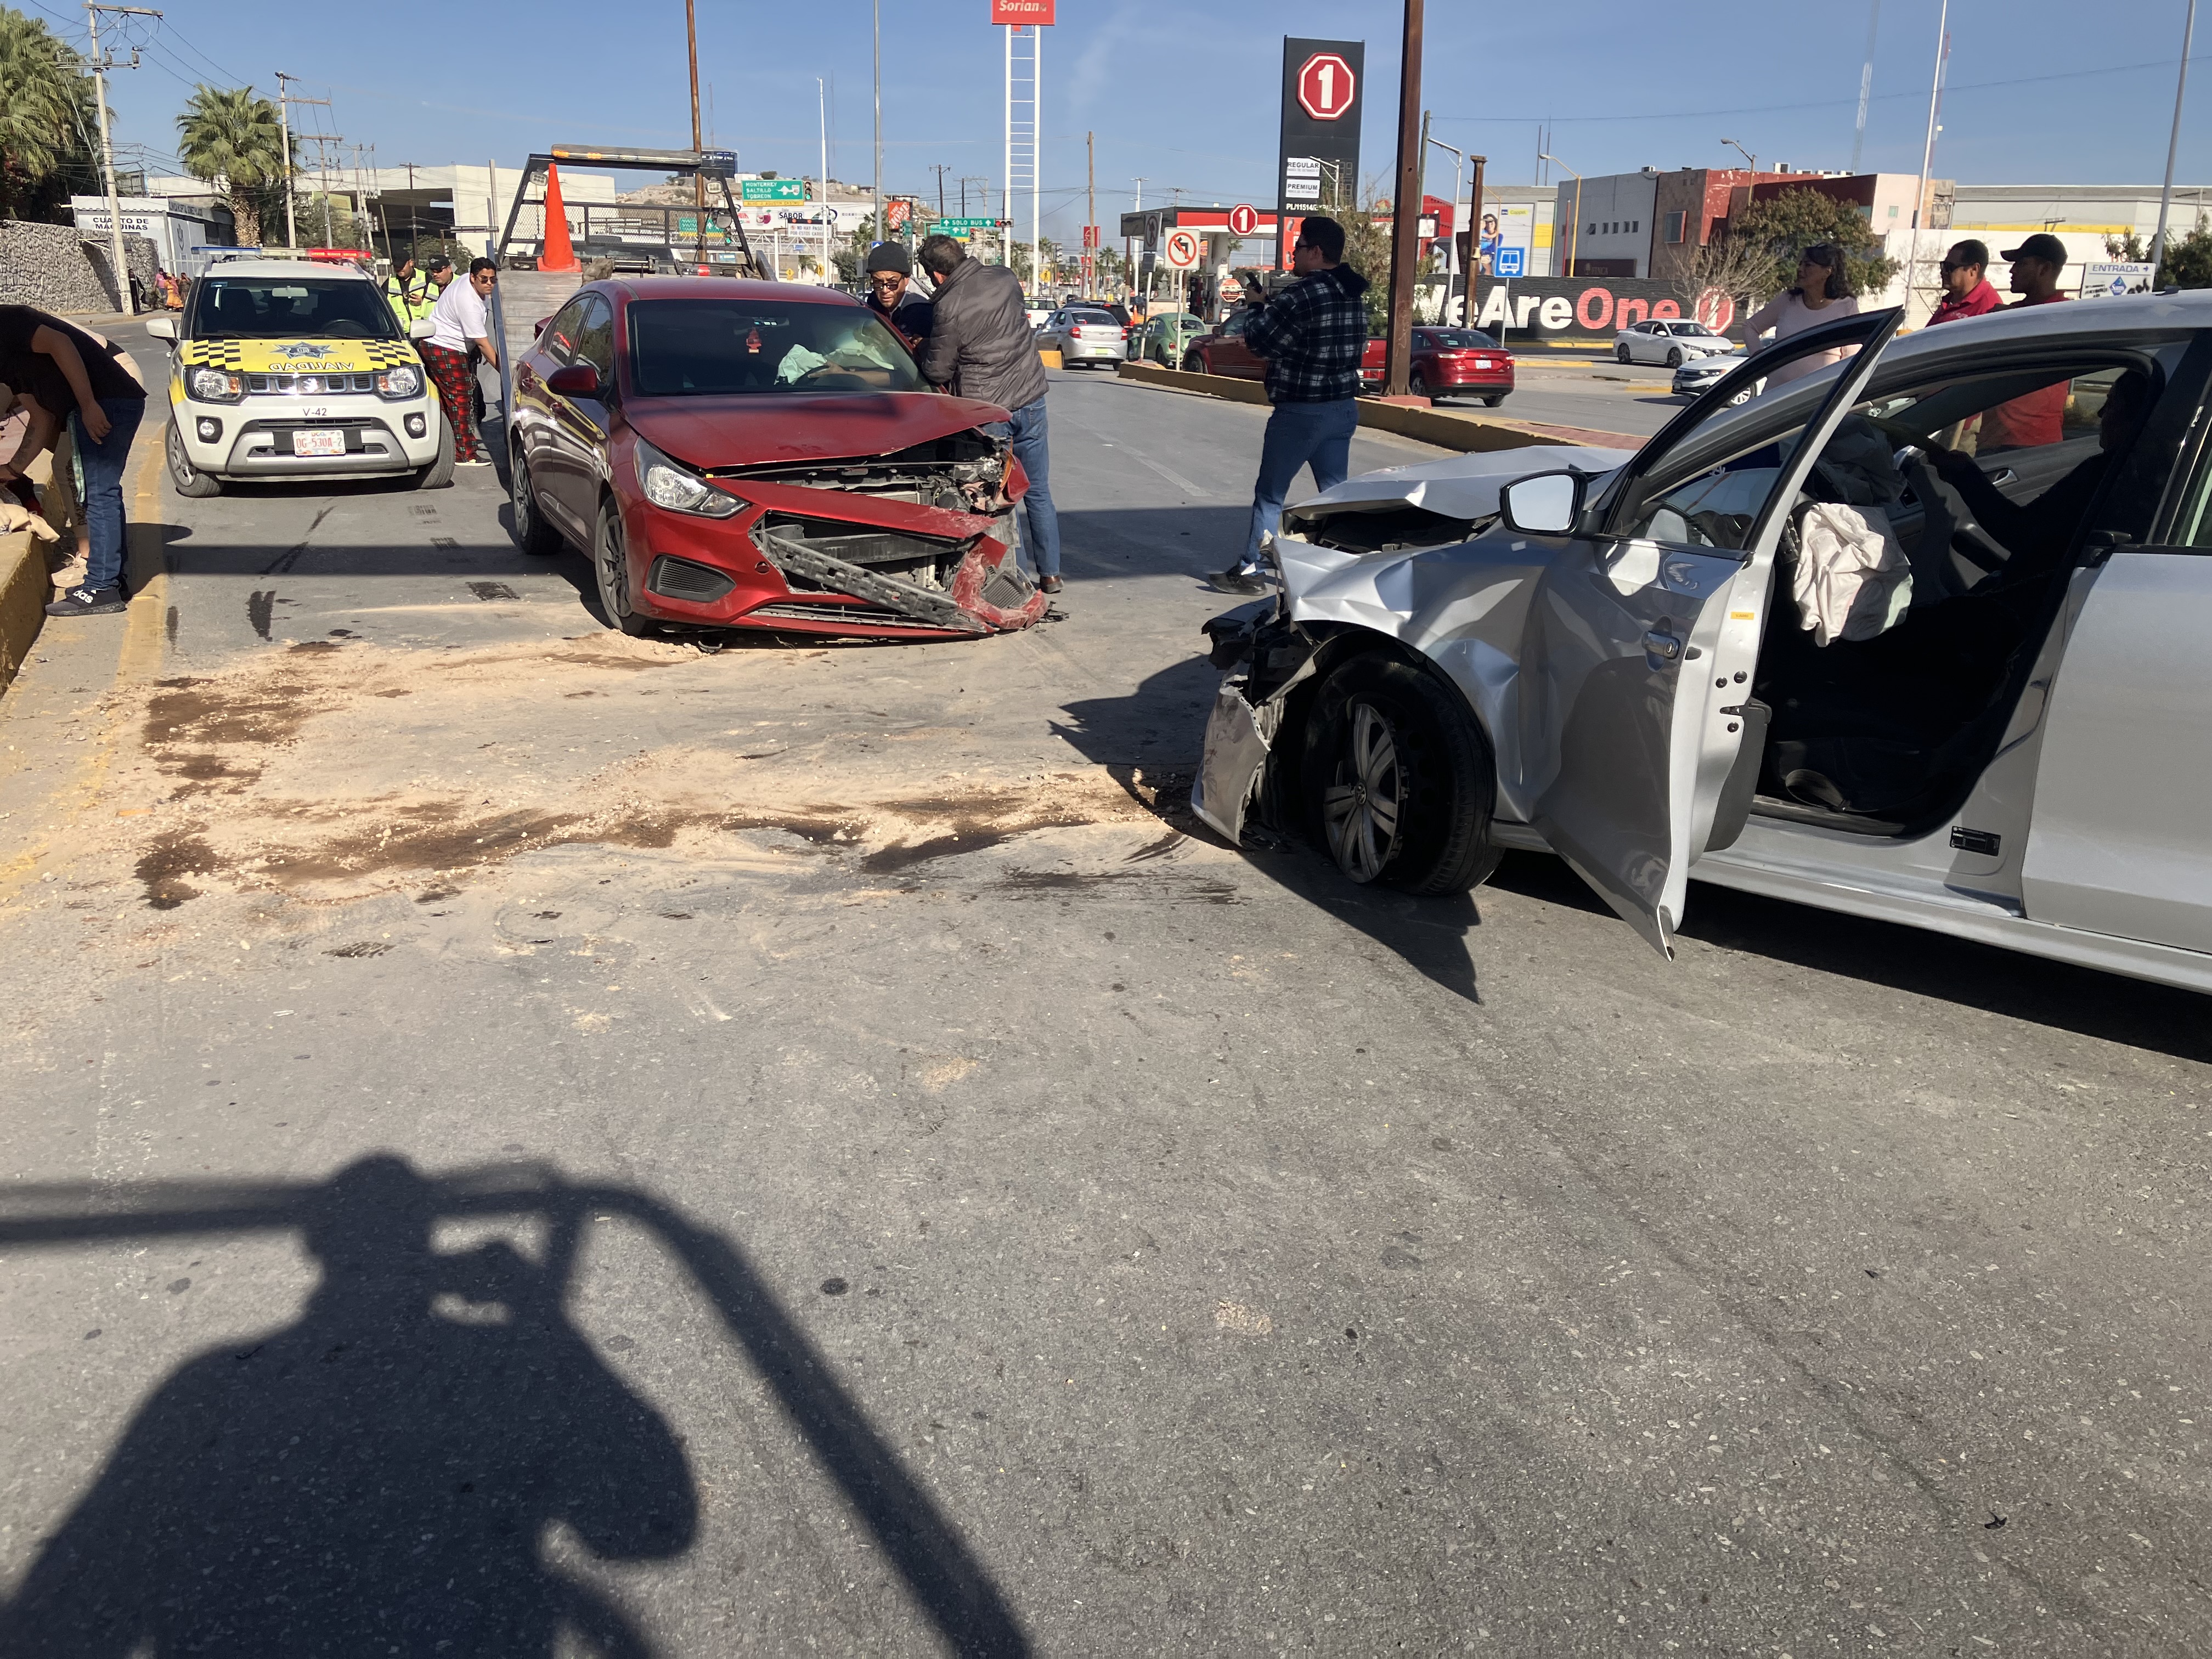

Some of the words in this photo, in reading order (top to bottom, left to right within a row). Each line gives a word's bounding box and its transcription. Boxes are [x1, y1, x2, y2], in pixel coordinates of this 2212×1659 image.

[1318, 64, 1334, 109] 1
[1239, 208, 1248, 232] 1
[303, 408, 327, 416] V-42
